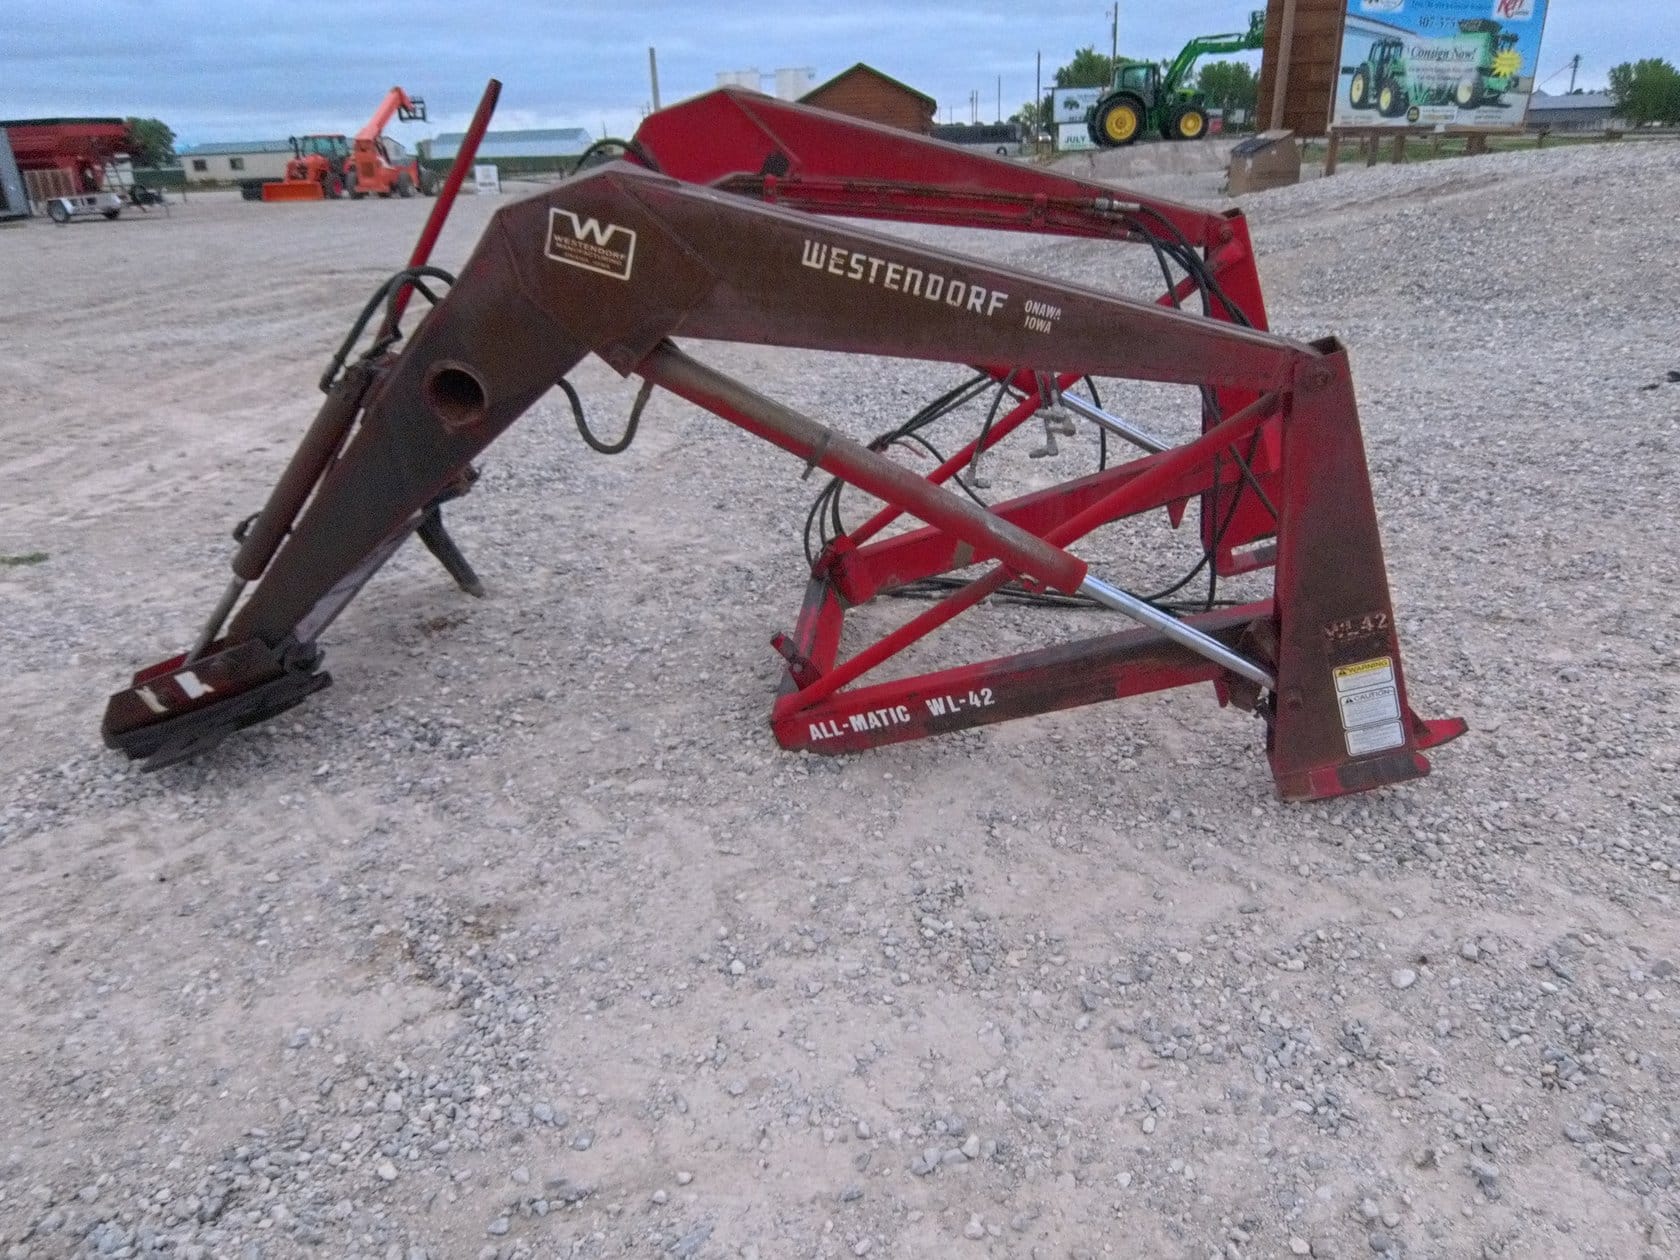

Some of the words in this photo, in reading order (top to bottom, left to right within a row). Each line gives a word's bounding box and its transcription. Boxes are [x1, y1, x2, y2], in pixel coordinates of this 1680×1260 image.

[1065, 136, 1086, 144] JULY
[553, 234, 626, 260] WESTENDORF
[801, 239, 1009, 317] WESTENDORF
[1024, 299, 1062, 321] ONAWA
[1024, 315, 1052, 335] IOWA
[1349, 660, 1388, 673] WARNING
[1353, 689, 1390, 702] CAUTION
[808, 704, 911, 741] ALL-MATIC
[925, 687, 995, 717] WL-42
